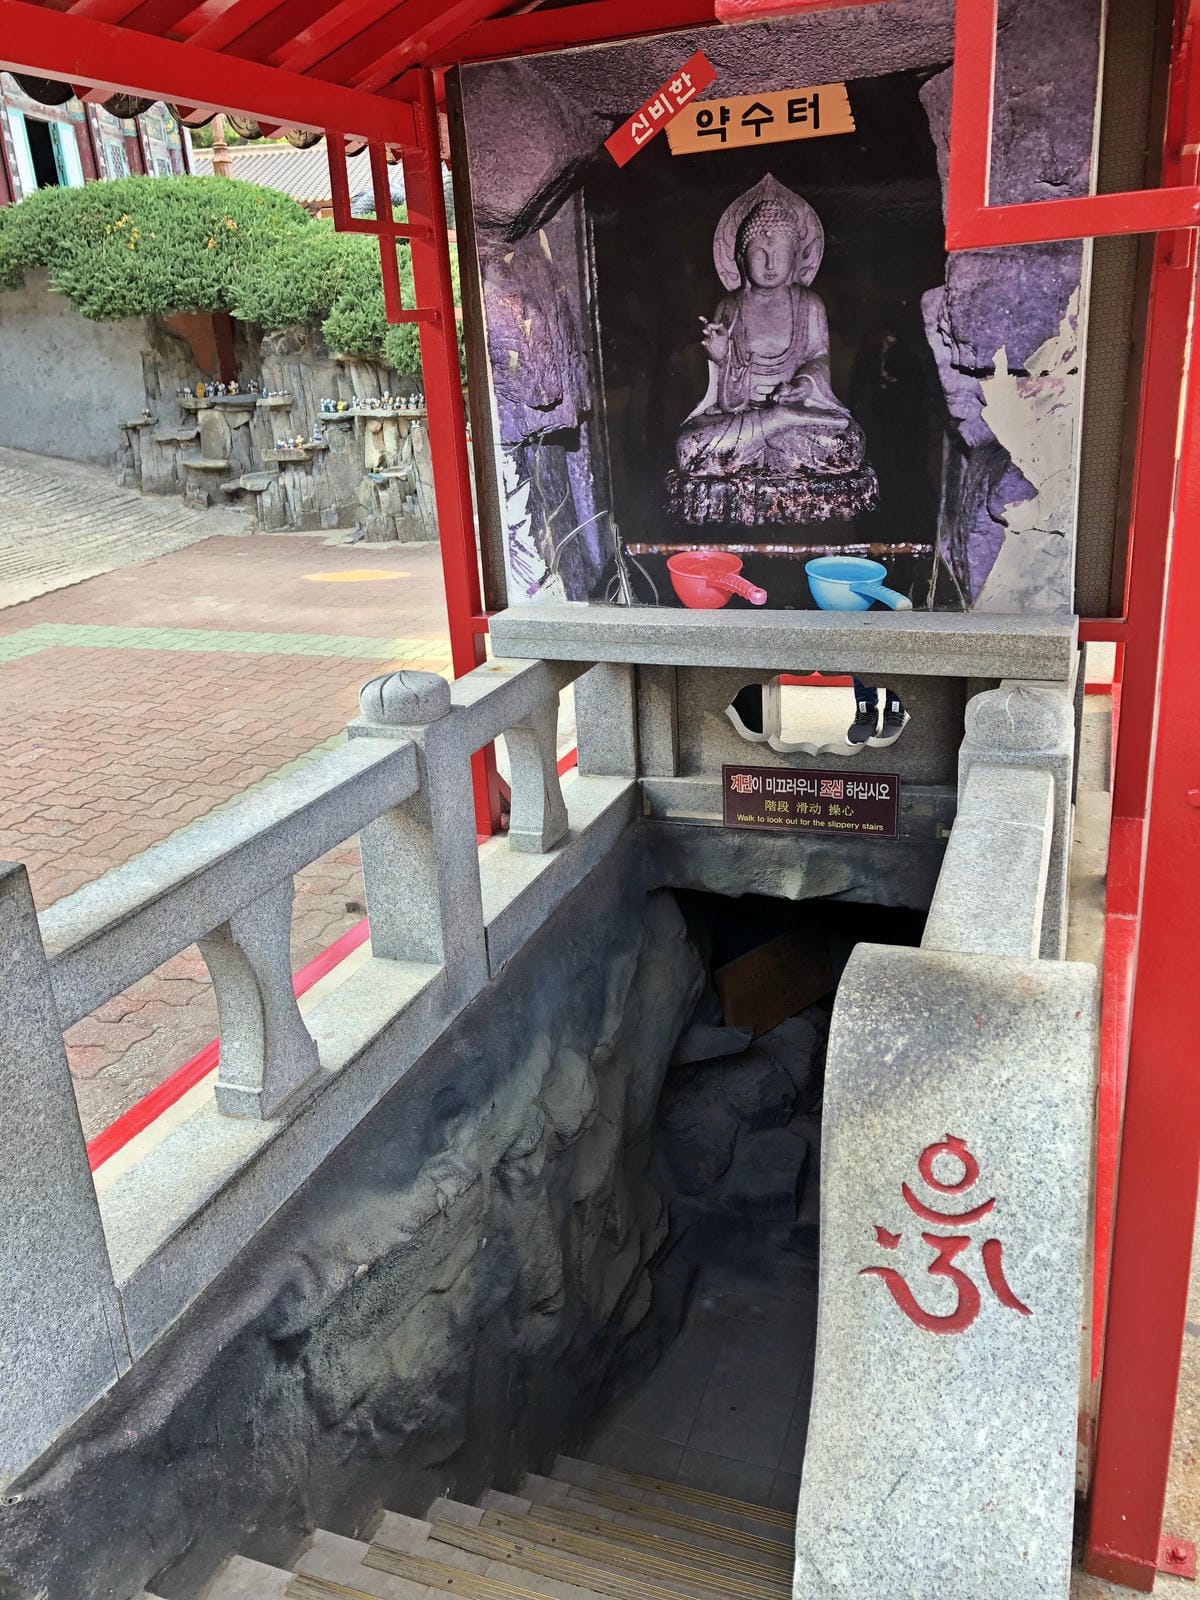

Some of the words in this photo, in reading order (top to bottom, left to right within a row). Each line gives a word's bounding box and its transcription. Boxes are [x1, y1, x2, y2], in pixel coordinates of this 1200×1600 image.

[630, 71, 697, 145] 신비한
[695, 93, 820, 143] 약수터
[730, 774, 762, 794] 계단이
[766, 776, 818, 797] 미끄러우니
[820, 779, 844, 799] 조심
[846, 781, 891, 801] 하십시오
[764, 799, 790, 813] 階段
[796, 801, 822, 815] 滑动
[828, 803, 855, 816] 操心
[736, 814, 755, 822] Walk
[757, 815, 765, 823] to
[766, 816, 783, 824] look
[800, 818, 811, 826] for
[812, 819, 825, 827] the
[827, 820, 860, 831] slippery
[862, 822, 884, 831] stairs
